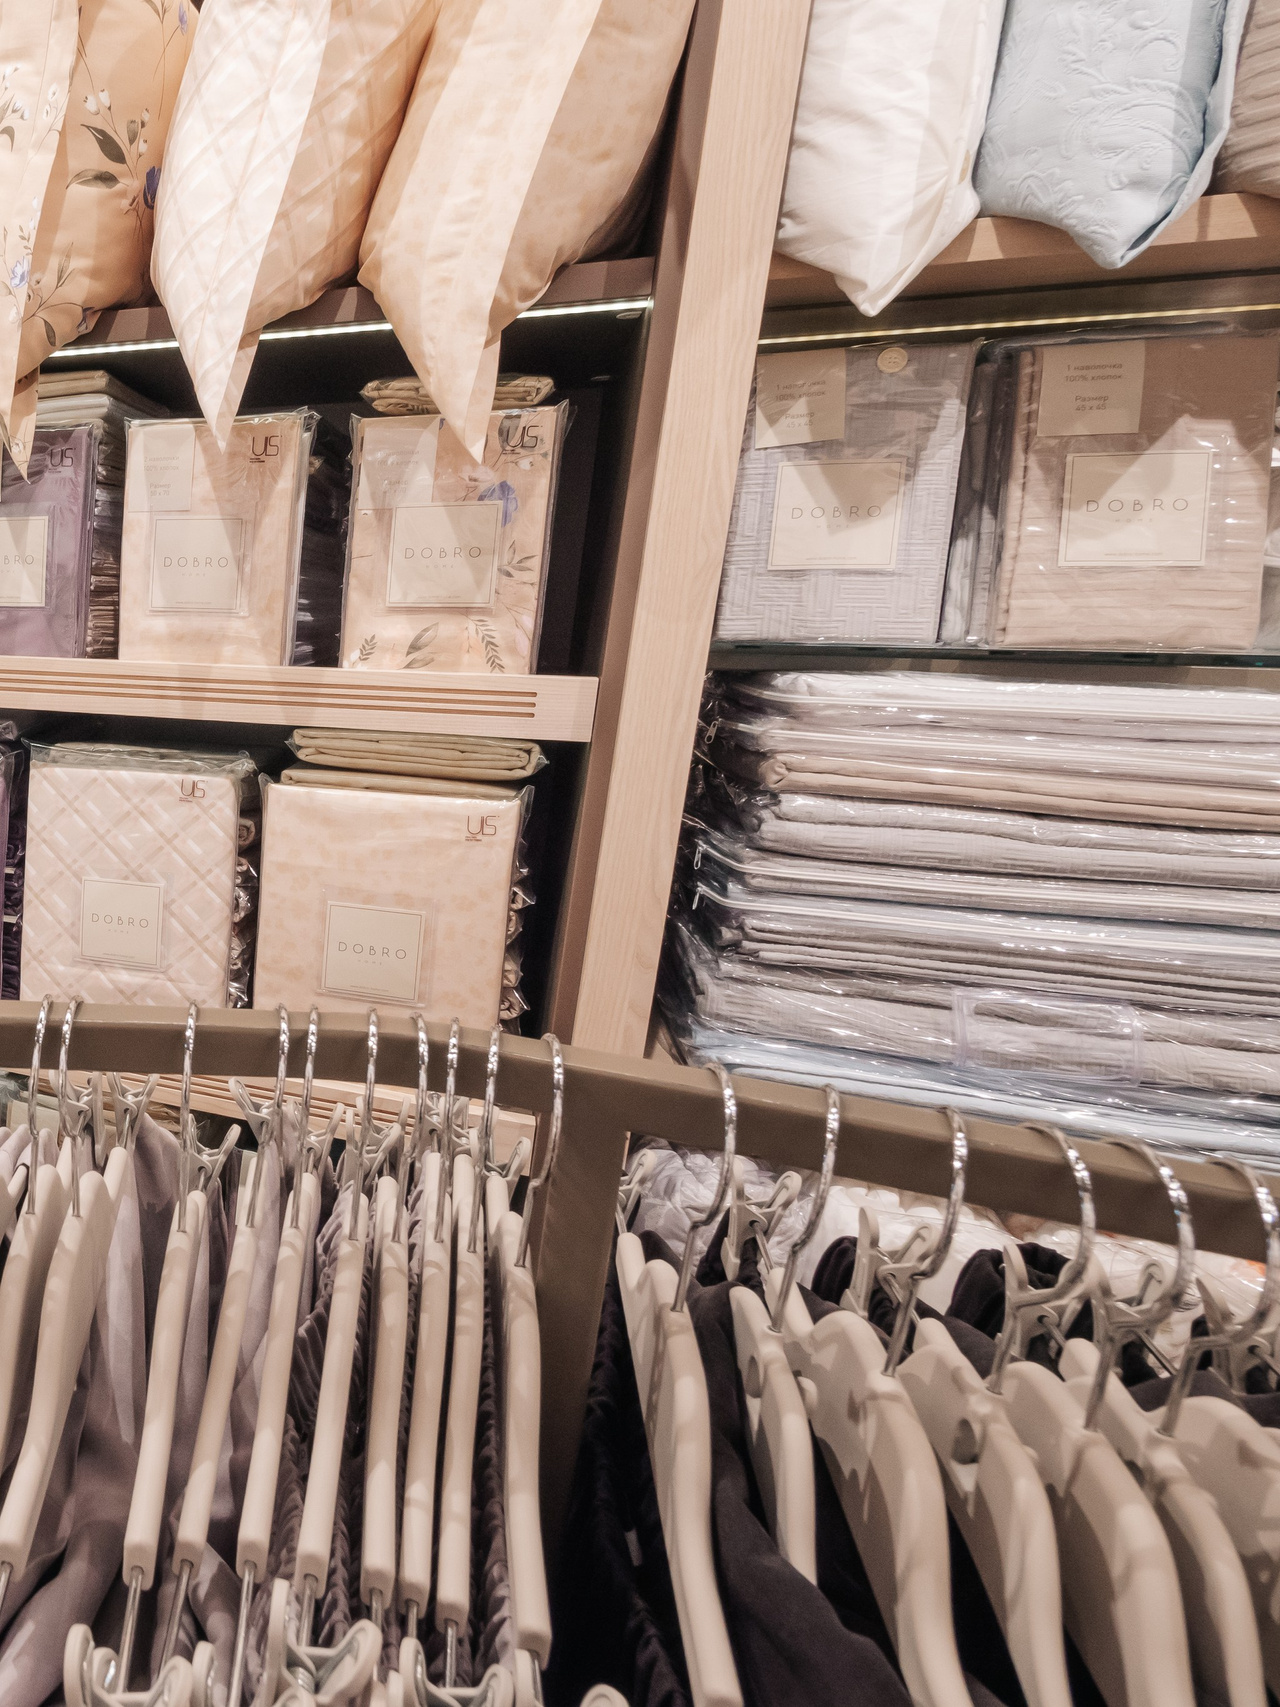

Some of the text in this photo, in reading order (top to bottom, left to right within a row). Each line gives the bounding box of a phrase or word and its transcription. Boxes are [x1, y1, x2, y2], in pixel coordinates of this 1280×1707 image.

[1073, 363, 1123, 371] наволочка
[1074, 395, 1109, 403] Размер
[251, 435, 280, 457] US
[50, 447, 74, 468] US
[791, 505, 882, 520] DOBRO
[1086, 498, 1189, 513] DOBRO
[404, 546, 482, 560] DOBRO
[163, 556, 229, 568] DOBRO
[181, 779, 206, 798] US
[467, 815, 497, 836] US
[91, 912, 149, 929] DOBRO
[338, 941, 407, 960] DOBRO
